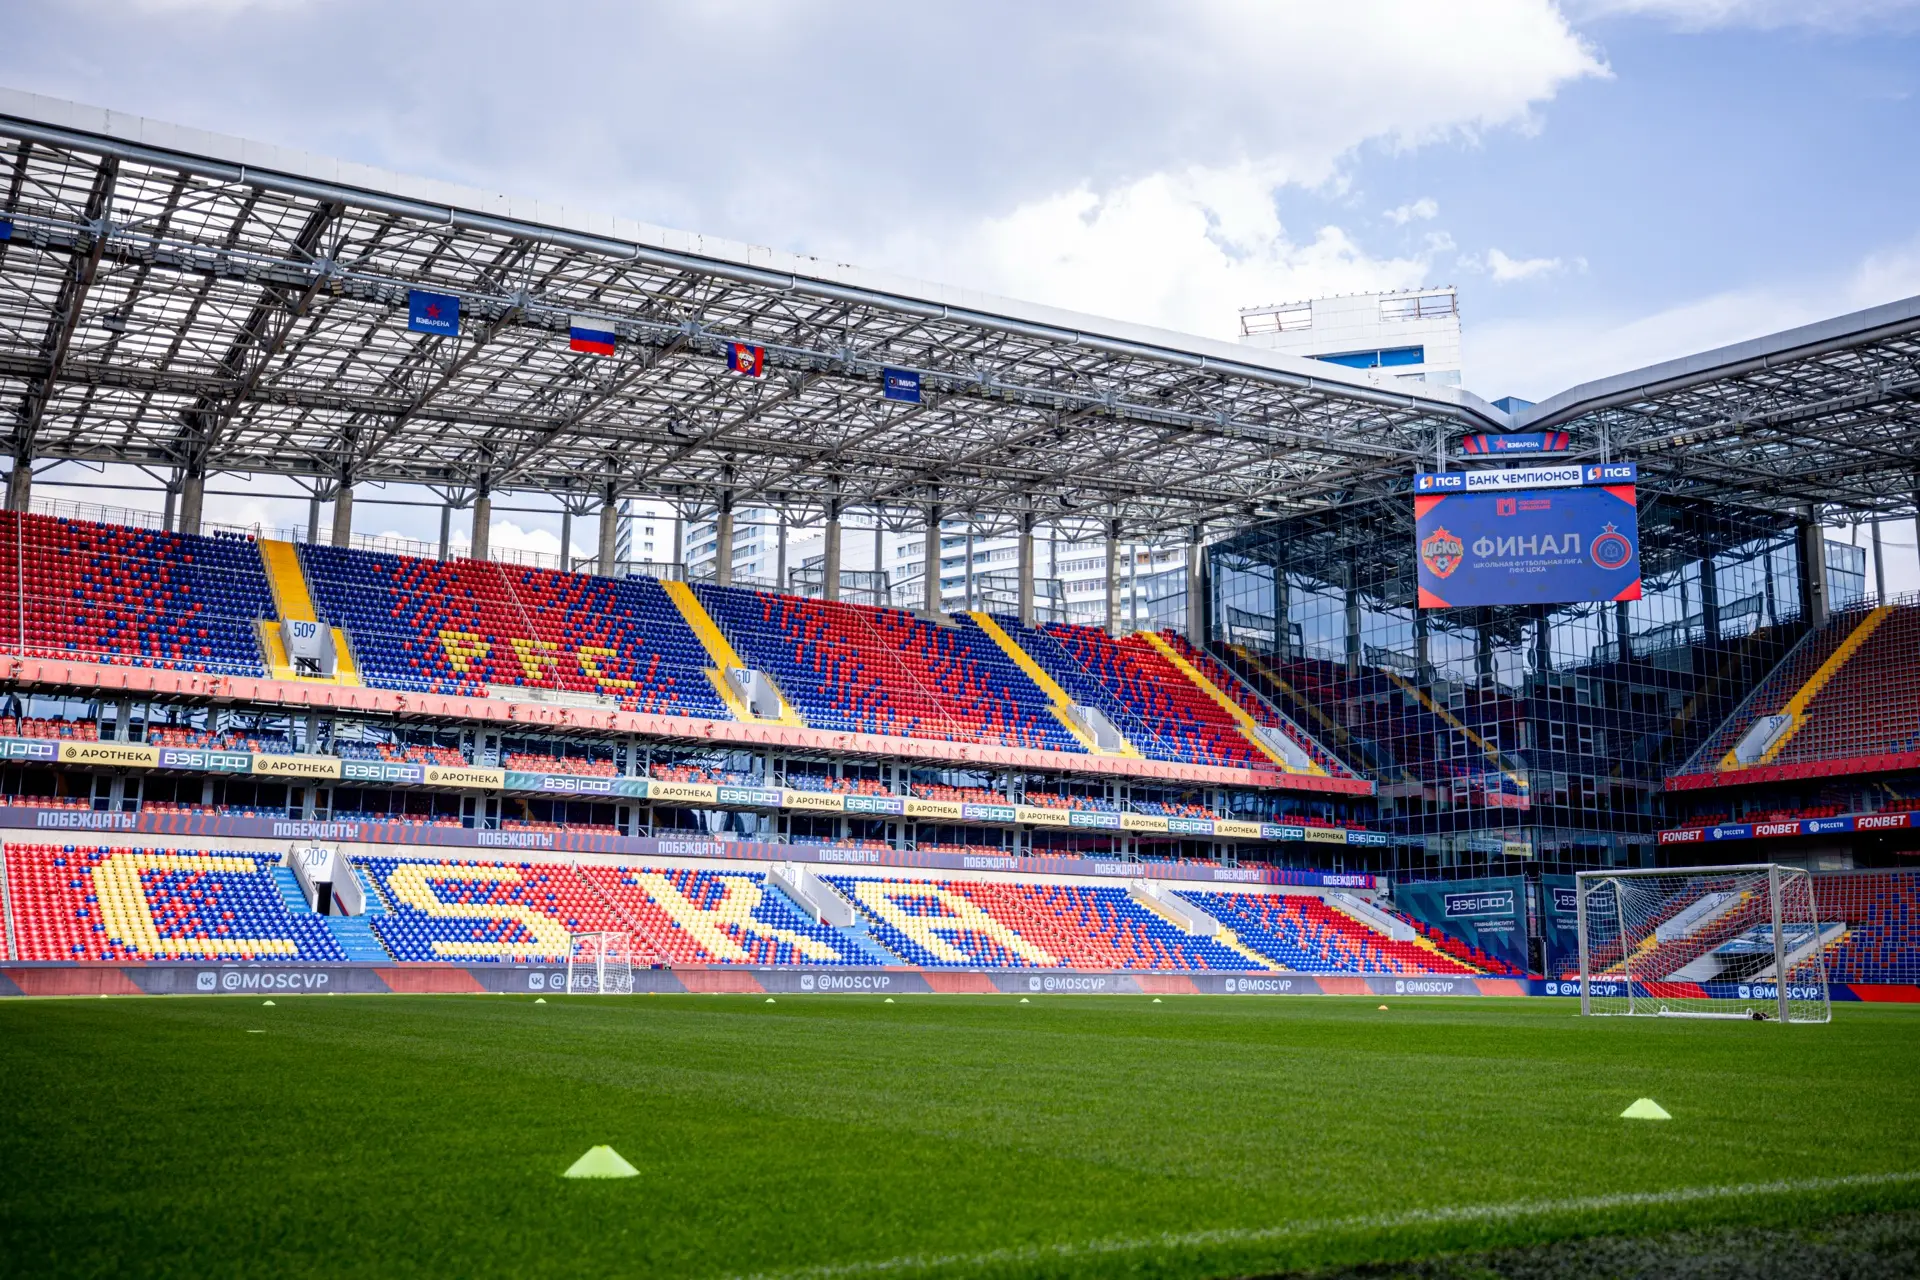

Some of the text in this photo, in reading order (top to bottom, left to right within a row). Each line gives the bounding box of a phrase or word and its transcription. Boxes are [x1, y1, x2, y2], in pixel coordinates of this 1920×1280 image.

[1468, 470, 1580, 486] БАНК ЧЕМПИОНОВ
[1604, 467, 1631, 478] ПСБ
[1435, 477, 1461, 487] ПСБ
[1472, 533, 1581, 559] ФИНАЛ
[1473, 561, 1514, 569] ШКОЛЬНАЯ
[1515, 559, 1563, 567] ФУТБОЛЬНАЯ
[1526, 566, 1547, 574] ЦСКА
[294, 622, 316, 638] 509
[735, 668, 751, 685] 510
[81, 749, 152, 762] APOTHEKA
[271, 761, 335, 774] APOTHEKA
[442, 772, 499, 784] APOTHEKA
[663, 787, 712, 798] APOTHEKA
[796, 796, 841, 807] APOTHEKA
[916, 804, 958, 814] APOTHEKA
[38, 812, 136, 829] ПОБЕЖДАТЬ!
[1027, 812, 1066, 822] APOTHEKA
[1131, 819, 1167, 828] APOTHEKA
[1858, 814, 1906, 829] FONBET
[273, 822, 358, 838] ПОБЕЖДАТЬ!
[1224, 826, 1258, 834] APOTHEKA
[1312, 832, 1344, 840] APOTHEKA
[1662, 830, 1702, 842] FONBET
[1756, 823, 1799, 836] FONBET
[478, 832, 552, 847] ПОБЕЖДАТЬ!
[658, 841, 725, 855] ПОБЕЖДАТЬ!
[304, 848, 328, 866] 209
[819, 849, 879, 862] ПОБЕЖДАТЬ!
[964, 856, 1018, 869] ПОБЕЖДАТЬ!
[1095, 863, 1144, 875] ПОБЕЖДАТЬ!
[1214, 870, 1260, 881] ПОБЕЖДАТЬ!
[1323, 875, 1365, 886] ПОБЕЖДАТЬ!
[222, 972, 328, 990] @MOSCVP
[818, 974, 890, 990] @MOSCVP
[1044, 977, 1106, 990] @MOSCVP
[1238, 979, 1292, 992] @MOSCVP
[1406, 982, 1454, 993] @MOSCVP
[1560, 983, 1618, 996] @MSCVP
